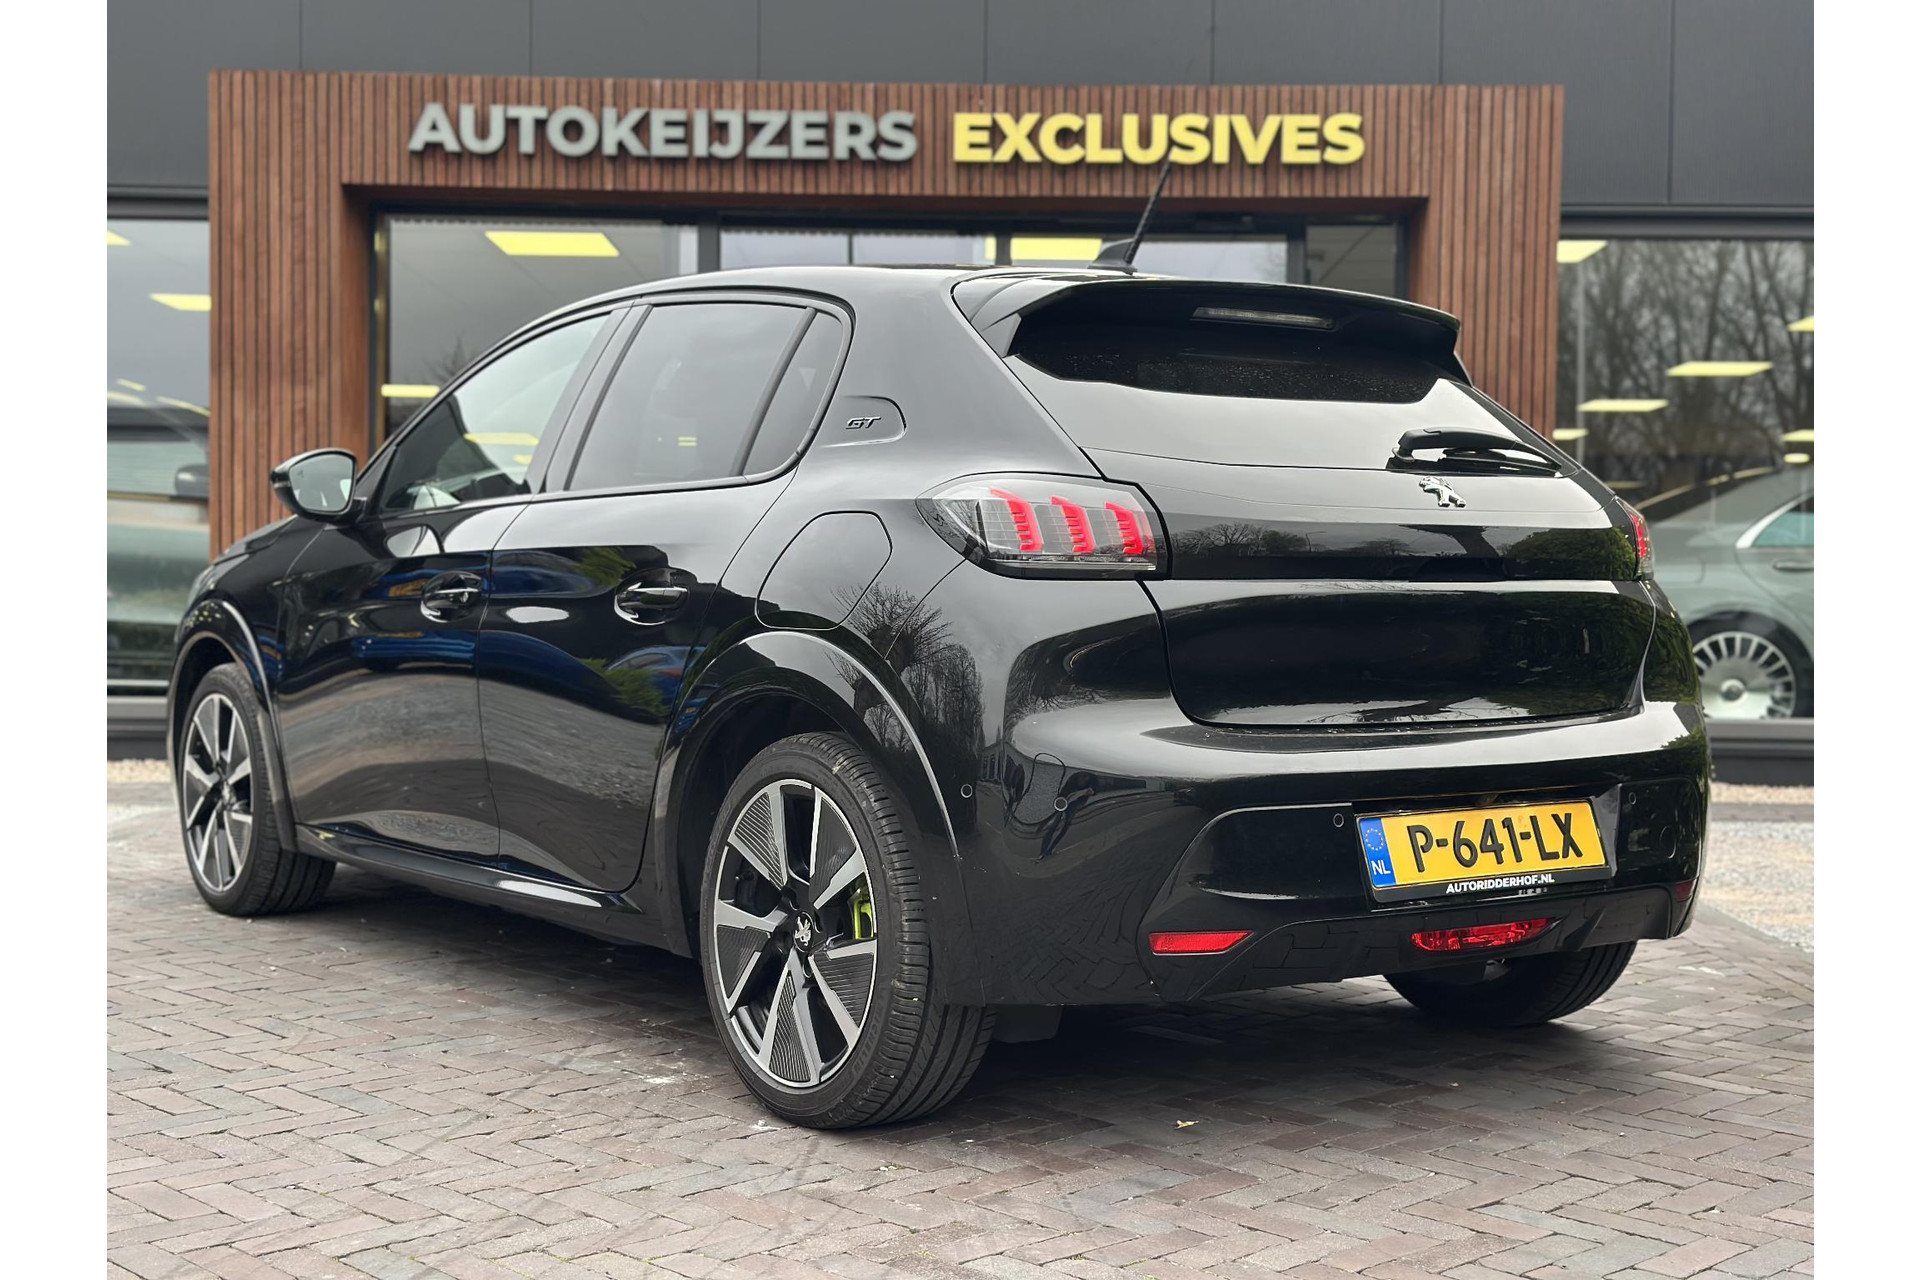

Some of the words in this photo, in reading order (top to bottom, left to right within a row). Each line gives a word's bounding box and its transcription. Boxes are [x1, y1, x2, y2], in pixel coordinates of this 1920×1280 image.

[408, 101, 918, 162] AUTOKEIJZERS
[952, 111, 1366, 165] EXCLUSIVES
[845, 416, 882, 430] GT
[1406, 812, 1584, 874] P-641-LX
[1370, 859, 1392, 876] NL
[1445, 873, 1556, 895] AUTORIDDERHOF.NL
